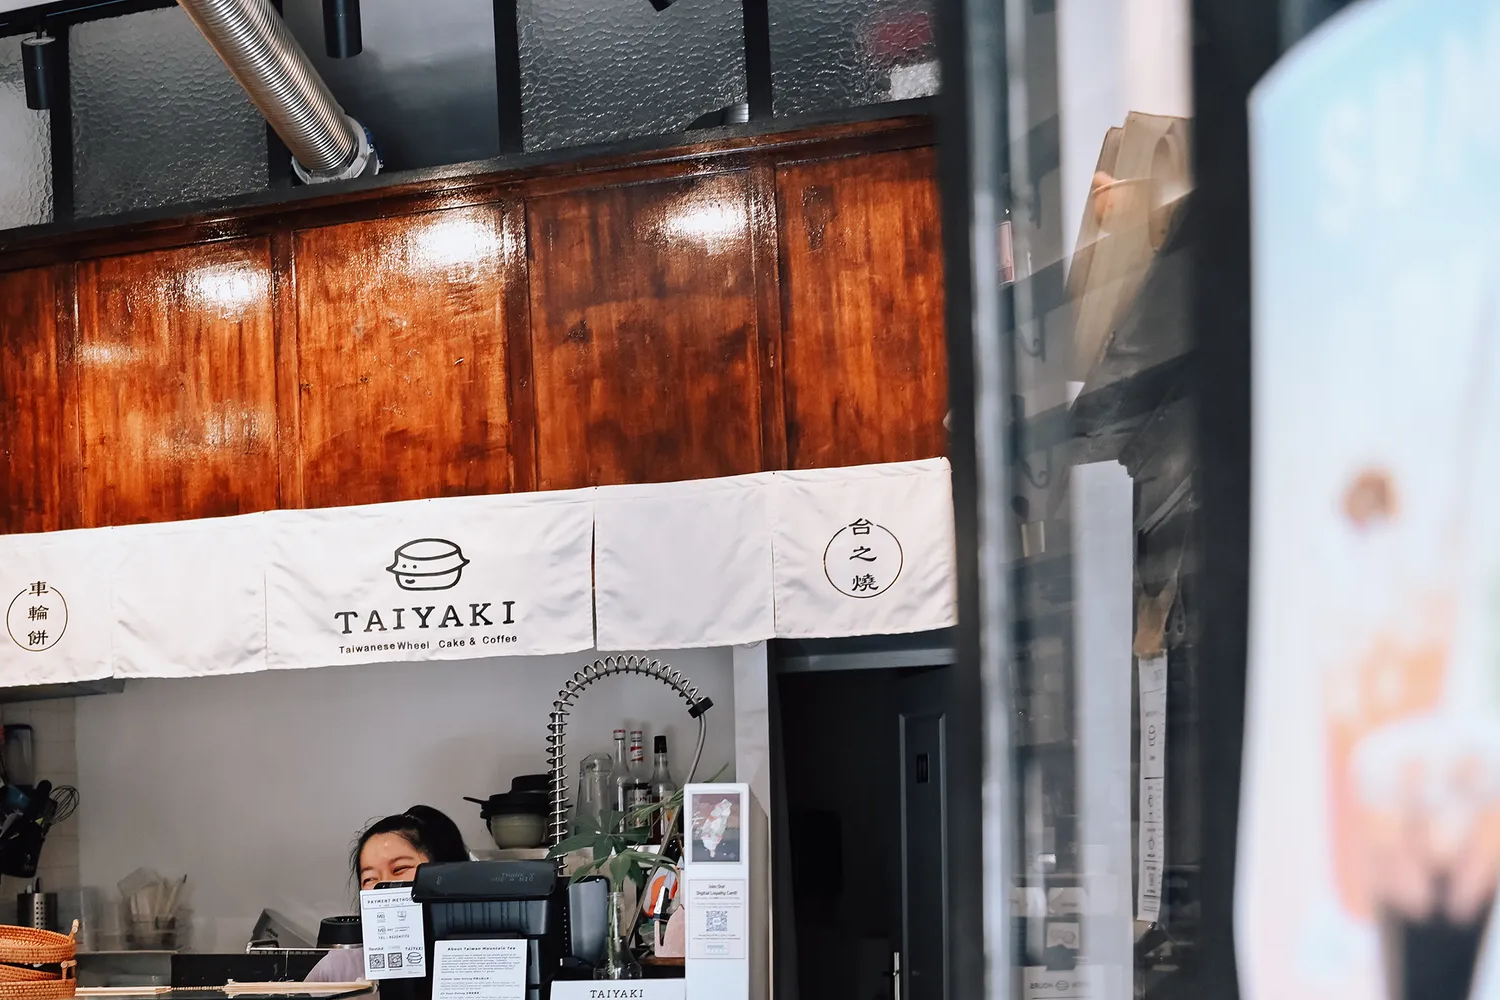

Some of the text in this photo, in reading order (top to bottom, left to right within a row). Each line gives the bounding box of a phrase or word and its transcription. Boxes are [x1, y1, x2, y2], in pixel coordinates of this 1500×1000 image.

[848, 518, 879, 591] 台之燒
[28, 581, 49, 645] 車輪餅
[334, 601, 516, 634] TAIYAKI
[397, 641, 430, 651] Wheel
[438, 637, 466, 649] Cake
[469, 637, 476, 646] &
[482, 635, 517, 645] Coffee
[590, 989, 643, 999] TAIYAKI
